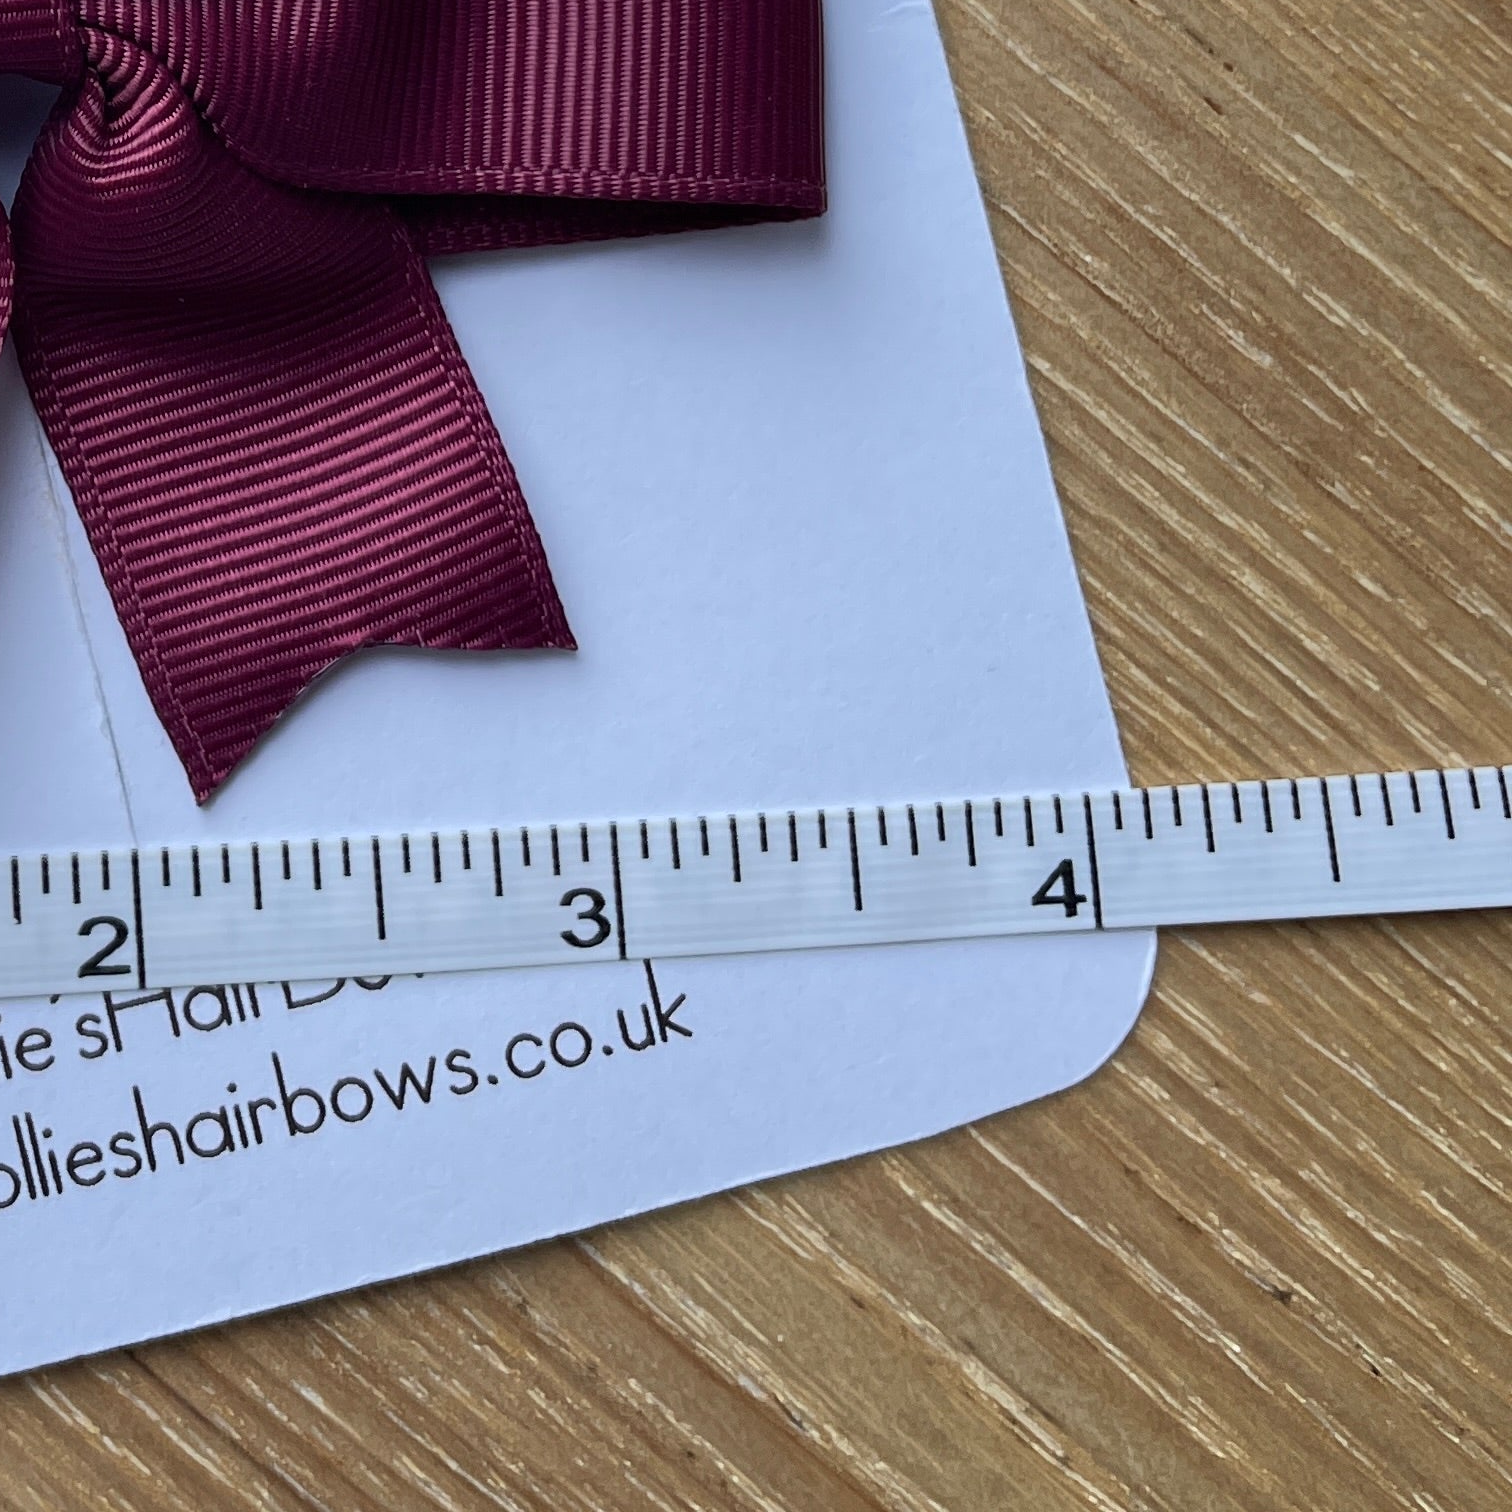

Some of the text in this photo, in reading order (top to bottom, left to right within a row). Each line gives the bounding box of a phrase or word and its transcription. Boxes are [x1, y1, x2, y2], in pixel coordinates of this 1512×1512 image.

[558, 887, 612, 949] 3
[1031, 858, 1088, 918] 4
[77, 915, 132, 979] 2
